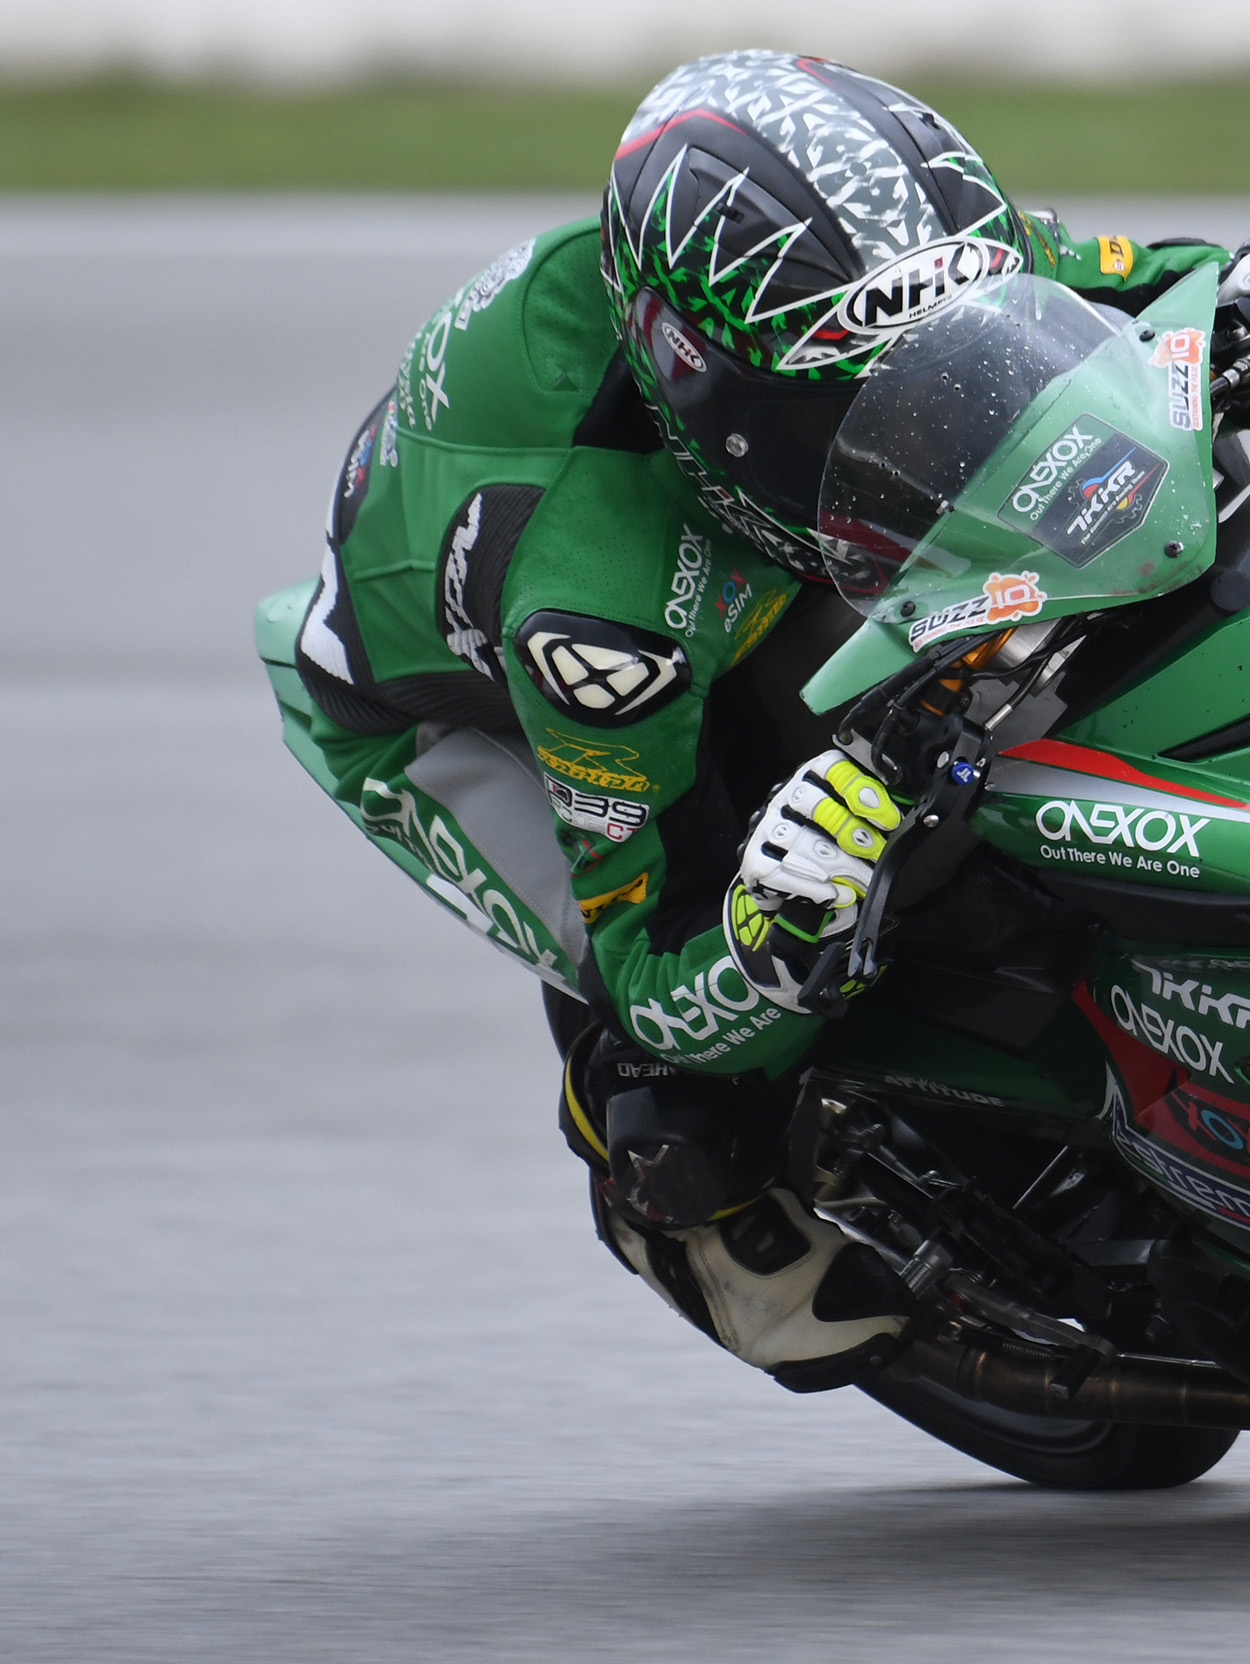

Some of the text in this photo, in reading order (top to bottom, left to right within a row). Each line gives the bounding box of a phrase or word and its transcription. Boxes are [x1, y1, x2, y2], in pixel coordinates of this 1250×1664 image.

[1030, 437, 1102, 521] Out There We Are One
[724, 583, 753, 633] eSIM
[1035, 799, 1211, 858] ONEXOX
[1039, 844, 1200, 878] Out There We Are One
[629, 955, 760, 1050] ONEXO
[723, 1026, 756, 1046] We
[749, 1006, 782, 1031] Are
